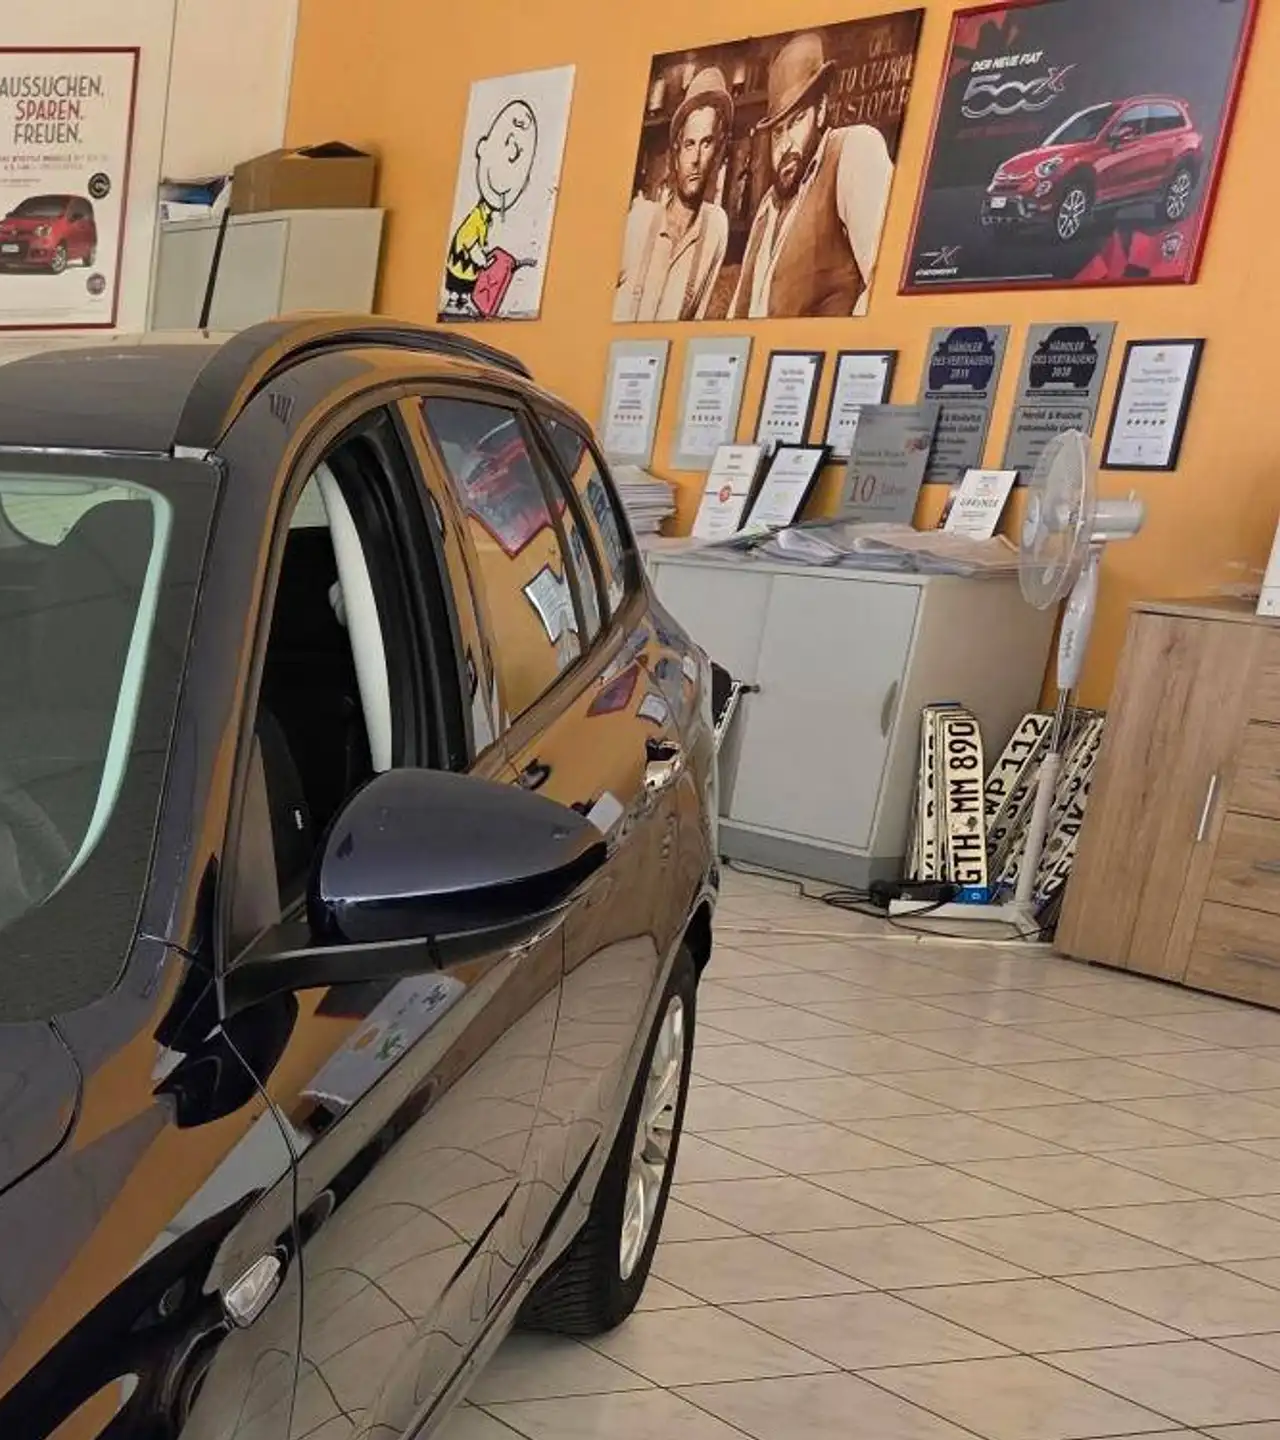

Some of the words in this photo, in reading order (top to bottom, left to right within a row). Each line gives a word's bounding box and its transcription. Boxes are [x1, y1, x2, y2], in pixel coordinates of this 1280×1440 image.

[15, 99, 84, 121] SPAREN.
[13, 123, 83, 144] FREUEN.
[948, 721, 978, 770] 890
[1001, 717, 1049, 773] 112
[950, 778, 979, 814] MM
[951, 833, 982, 885] GTH
